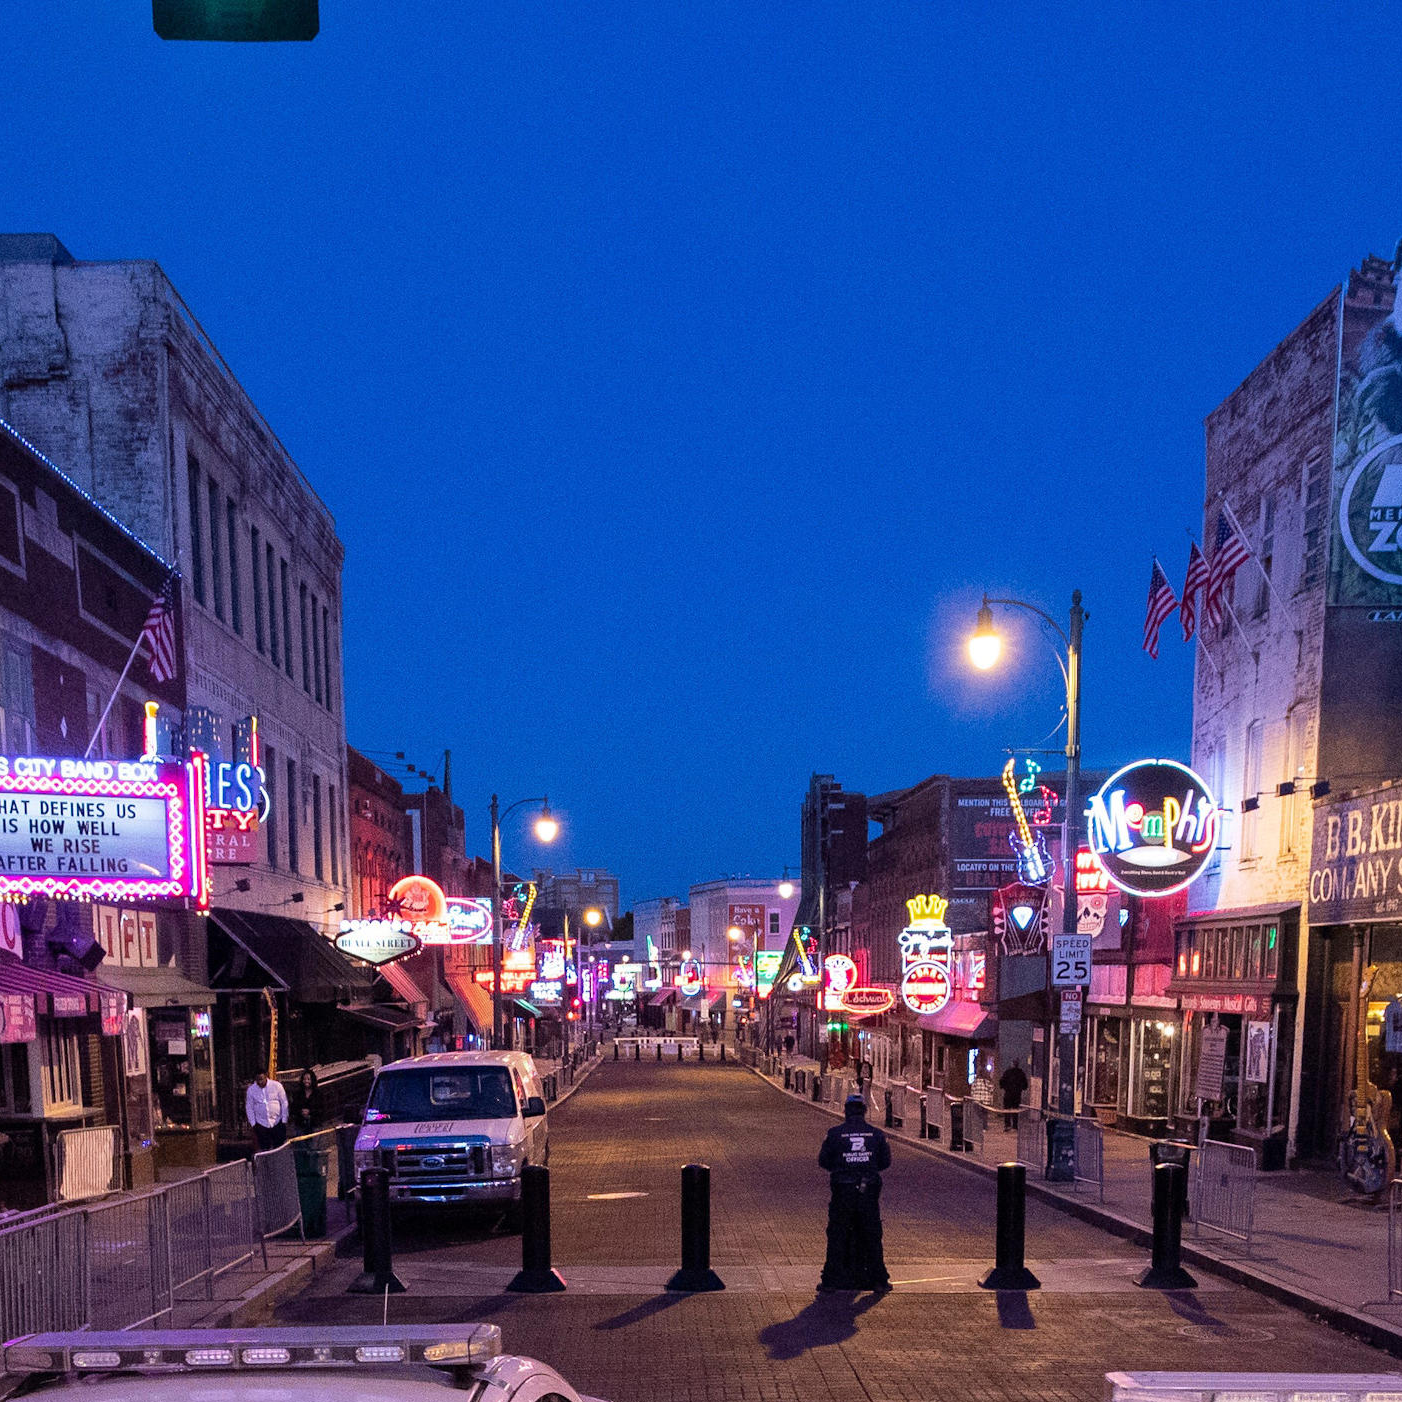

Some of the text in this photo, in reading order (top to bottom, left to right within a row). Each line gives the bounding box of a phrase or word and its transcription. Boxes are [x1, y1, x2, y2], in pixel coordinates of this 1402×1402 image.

[14, 757, 56, 779] CITY
[61, 759, 113, 781] BAND
[117, 762, 159, 782] BOX
[40, 801, 105, 818] DEFINES
[116, 804, 136, 819] US
[990, 808, 1010, 817] FREE
[3, 819, 121, 837] IS HOW WELL
[31, 838, 100, 854] WE RISE
[58, 857, 129, 873] FALLING
[376, 939, 413, 948] STREET
[1056, 939, 1089, 949] SPEED
[1059, 950, 1085, 959] LIMIT
[1056, 962, 1088, 979] 25
